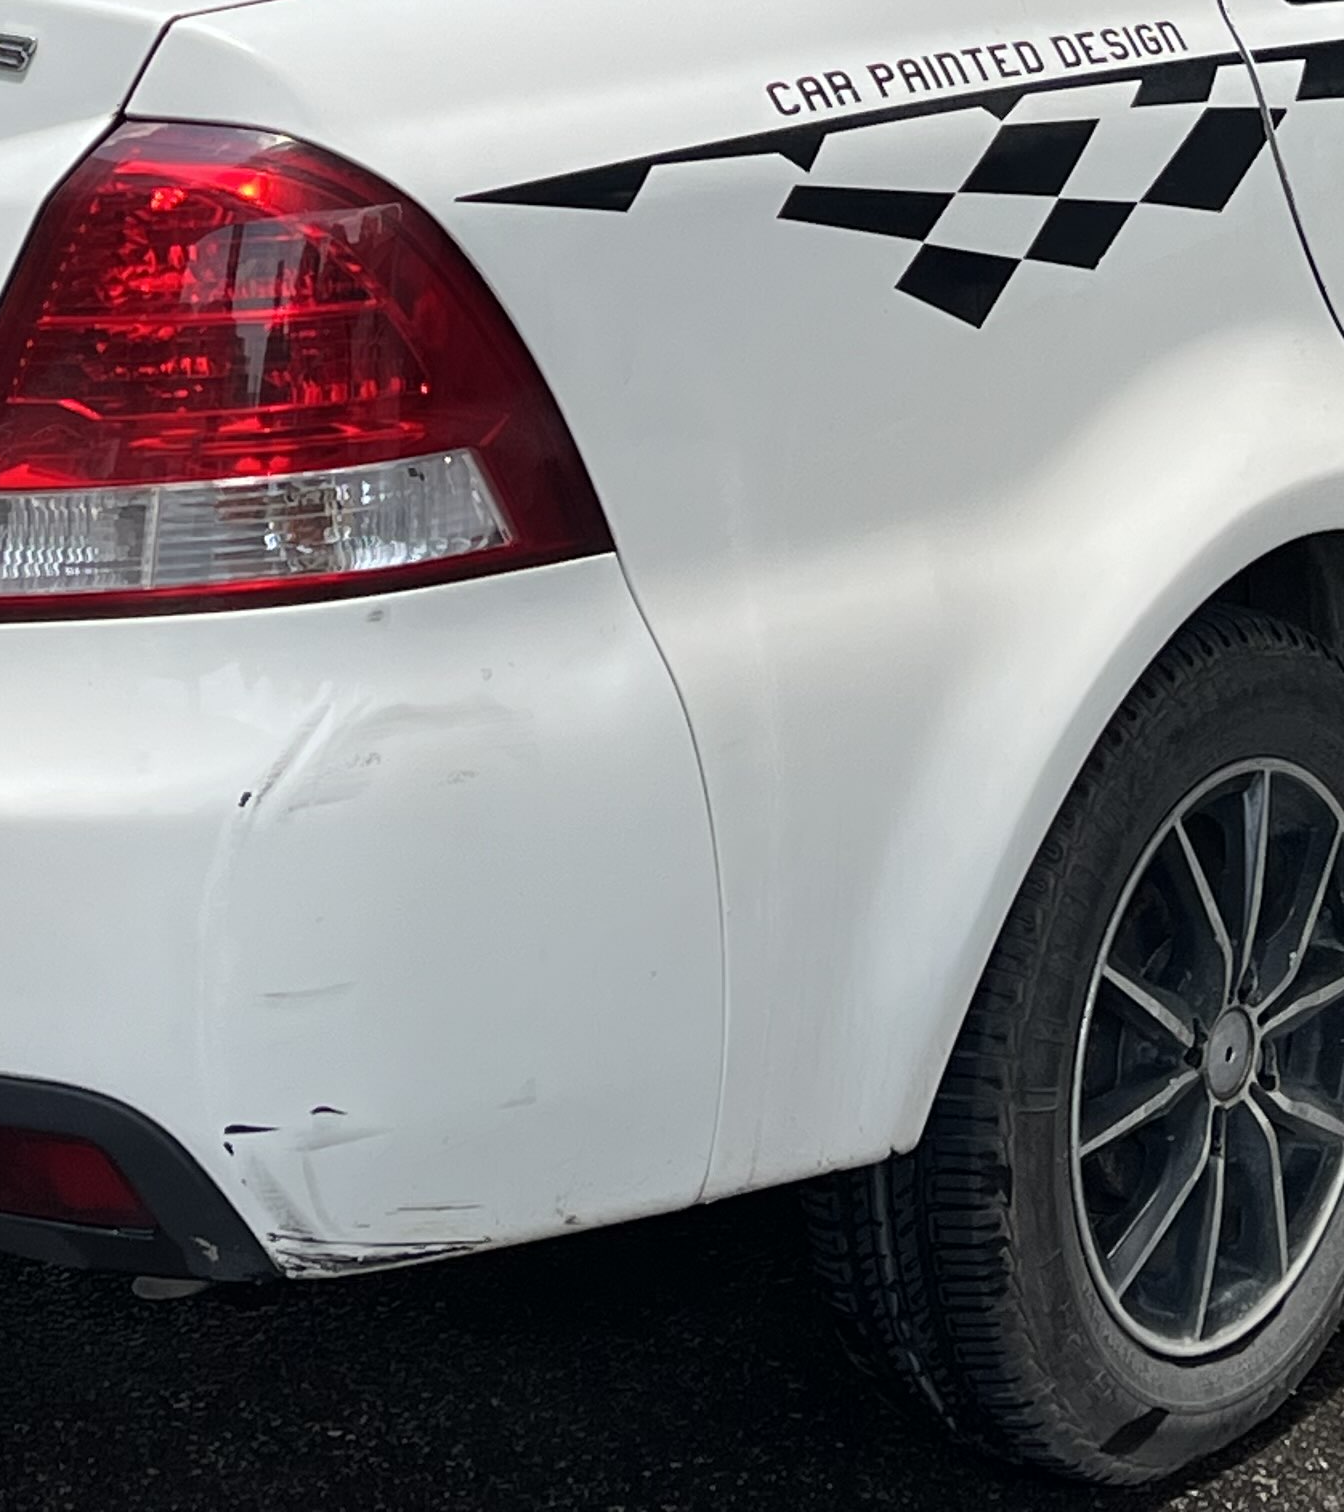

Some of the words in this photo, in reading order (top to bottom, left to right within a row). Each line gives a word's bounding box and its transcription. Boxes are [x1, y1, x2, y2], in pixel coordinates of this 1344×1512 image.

[766, 69, 861, 116] CAR
[866, 40, 1046, 98] PAINTED
[1050, 20, 1188, 68] DESIGN
